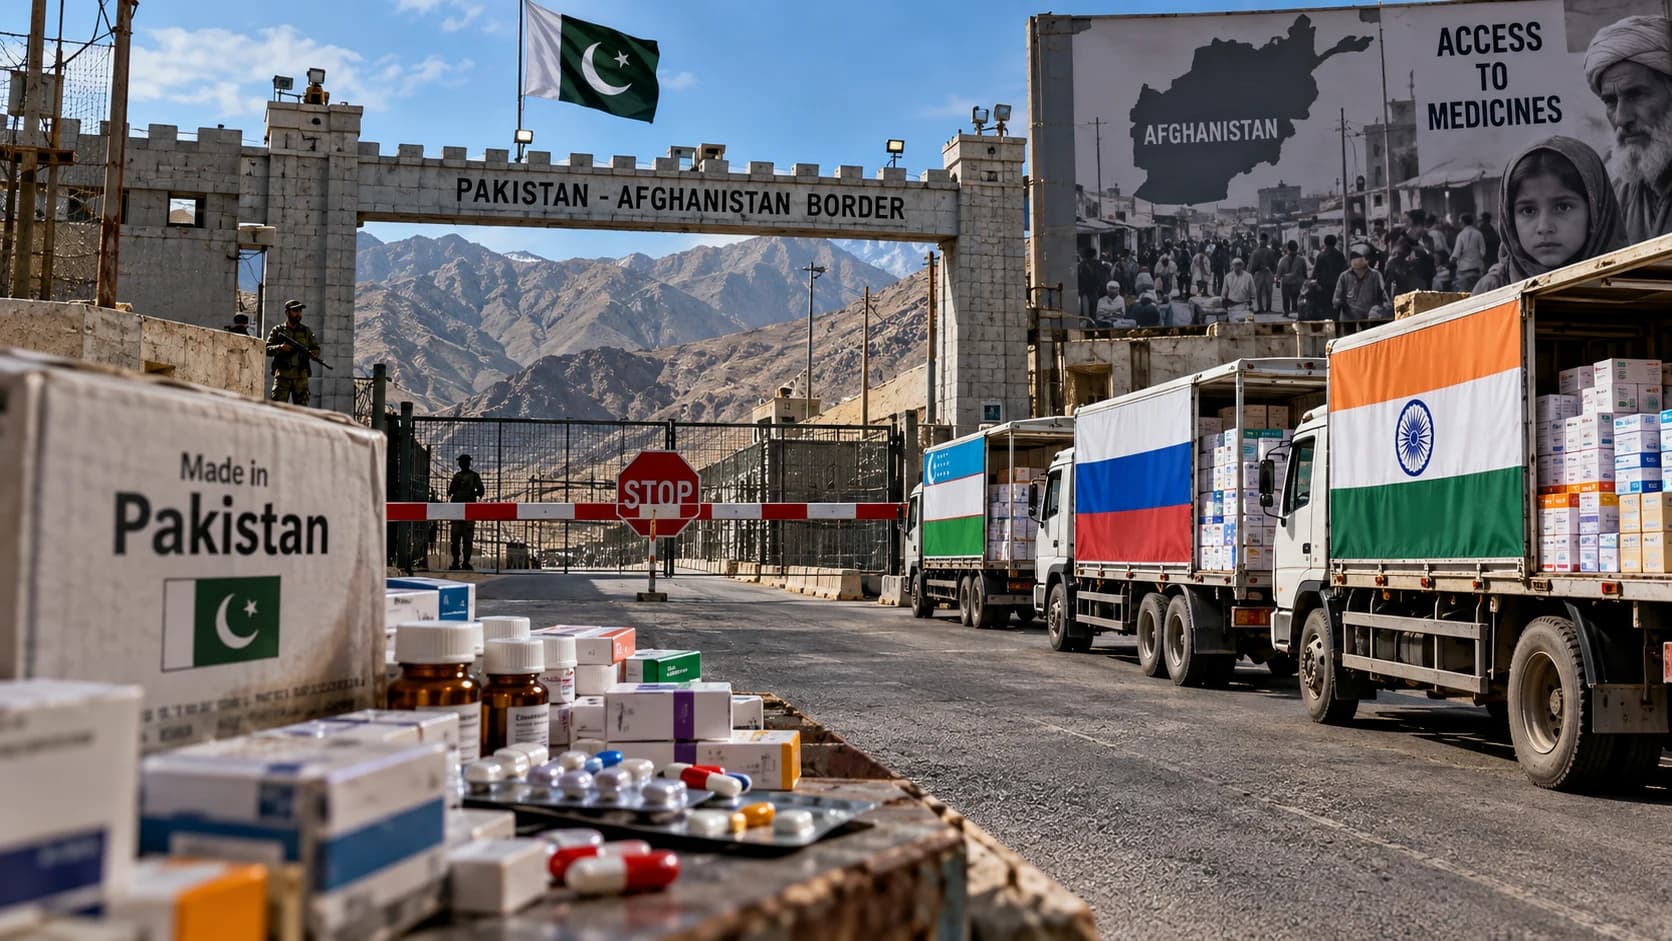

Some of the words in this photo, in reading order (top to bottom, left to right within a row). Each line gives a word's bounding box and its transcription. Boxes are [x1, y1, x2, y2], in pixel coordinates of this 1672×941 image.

[1437, 21, 1542, 57] ACCESS
[1475, 62, 1508, 91] TO
[1428, 95, 1562, 130] MEDICINES
[1143, 118, 1278, 145] AFGHANISTAN
[456, 177, 589, 207] PAKISTAN
[617, 185, 791, 215] AFGHANISTAN
[806, 193, 905, 220] BORDER
[180, 452, 244, 485] Made
[250, 460, 268, 487] in
[624, 480, 693, 509] STOP
[113, 491, 328, 555] Pakistan
